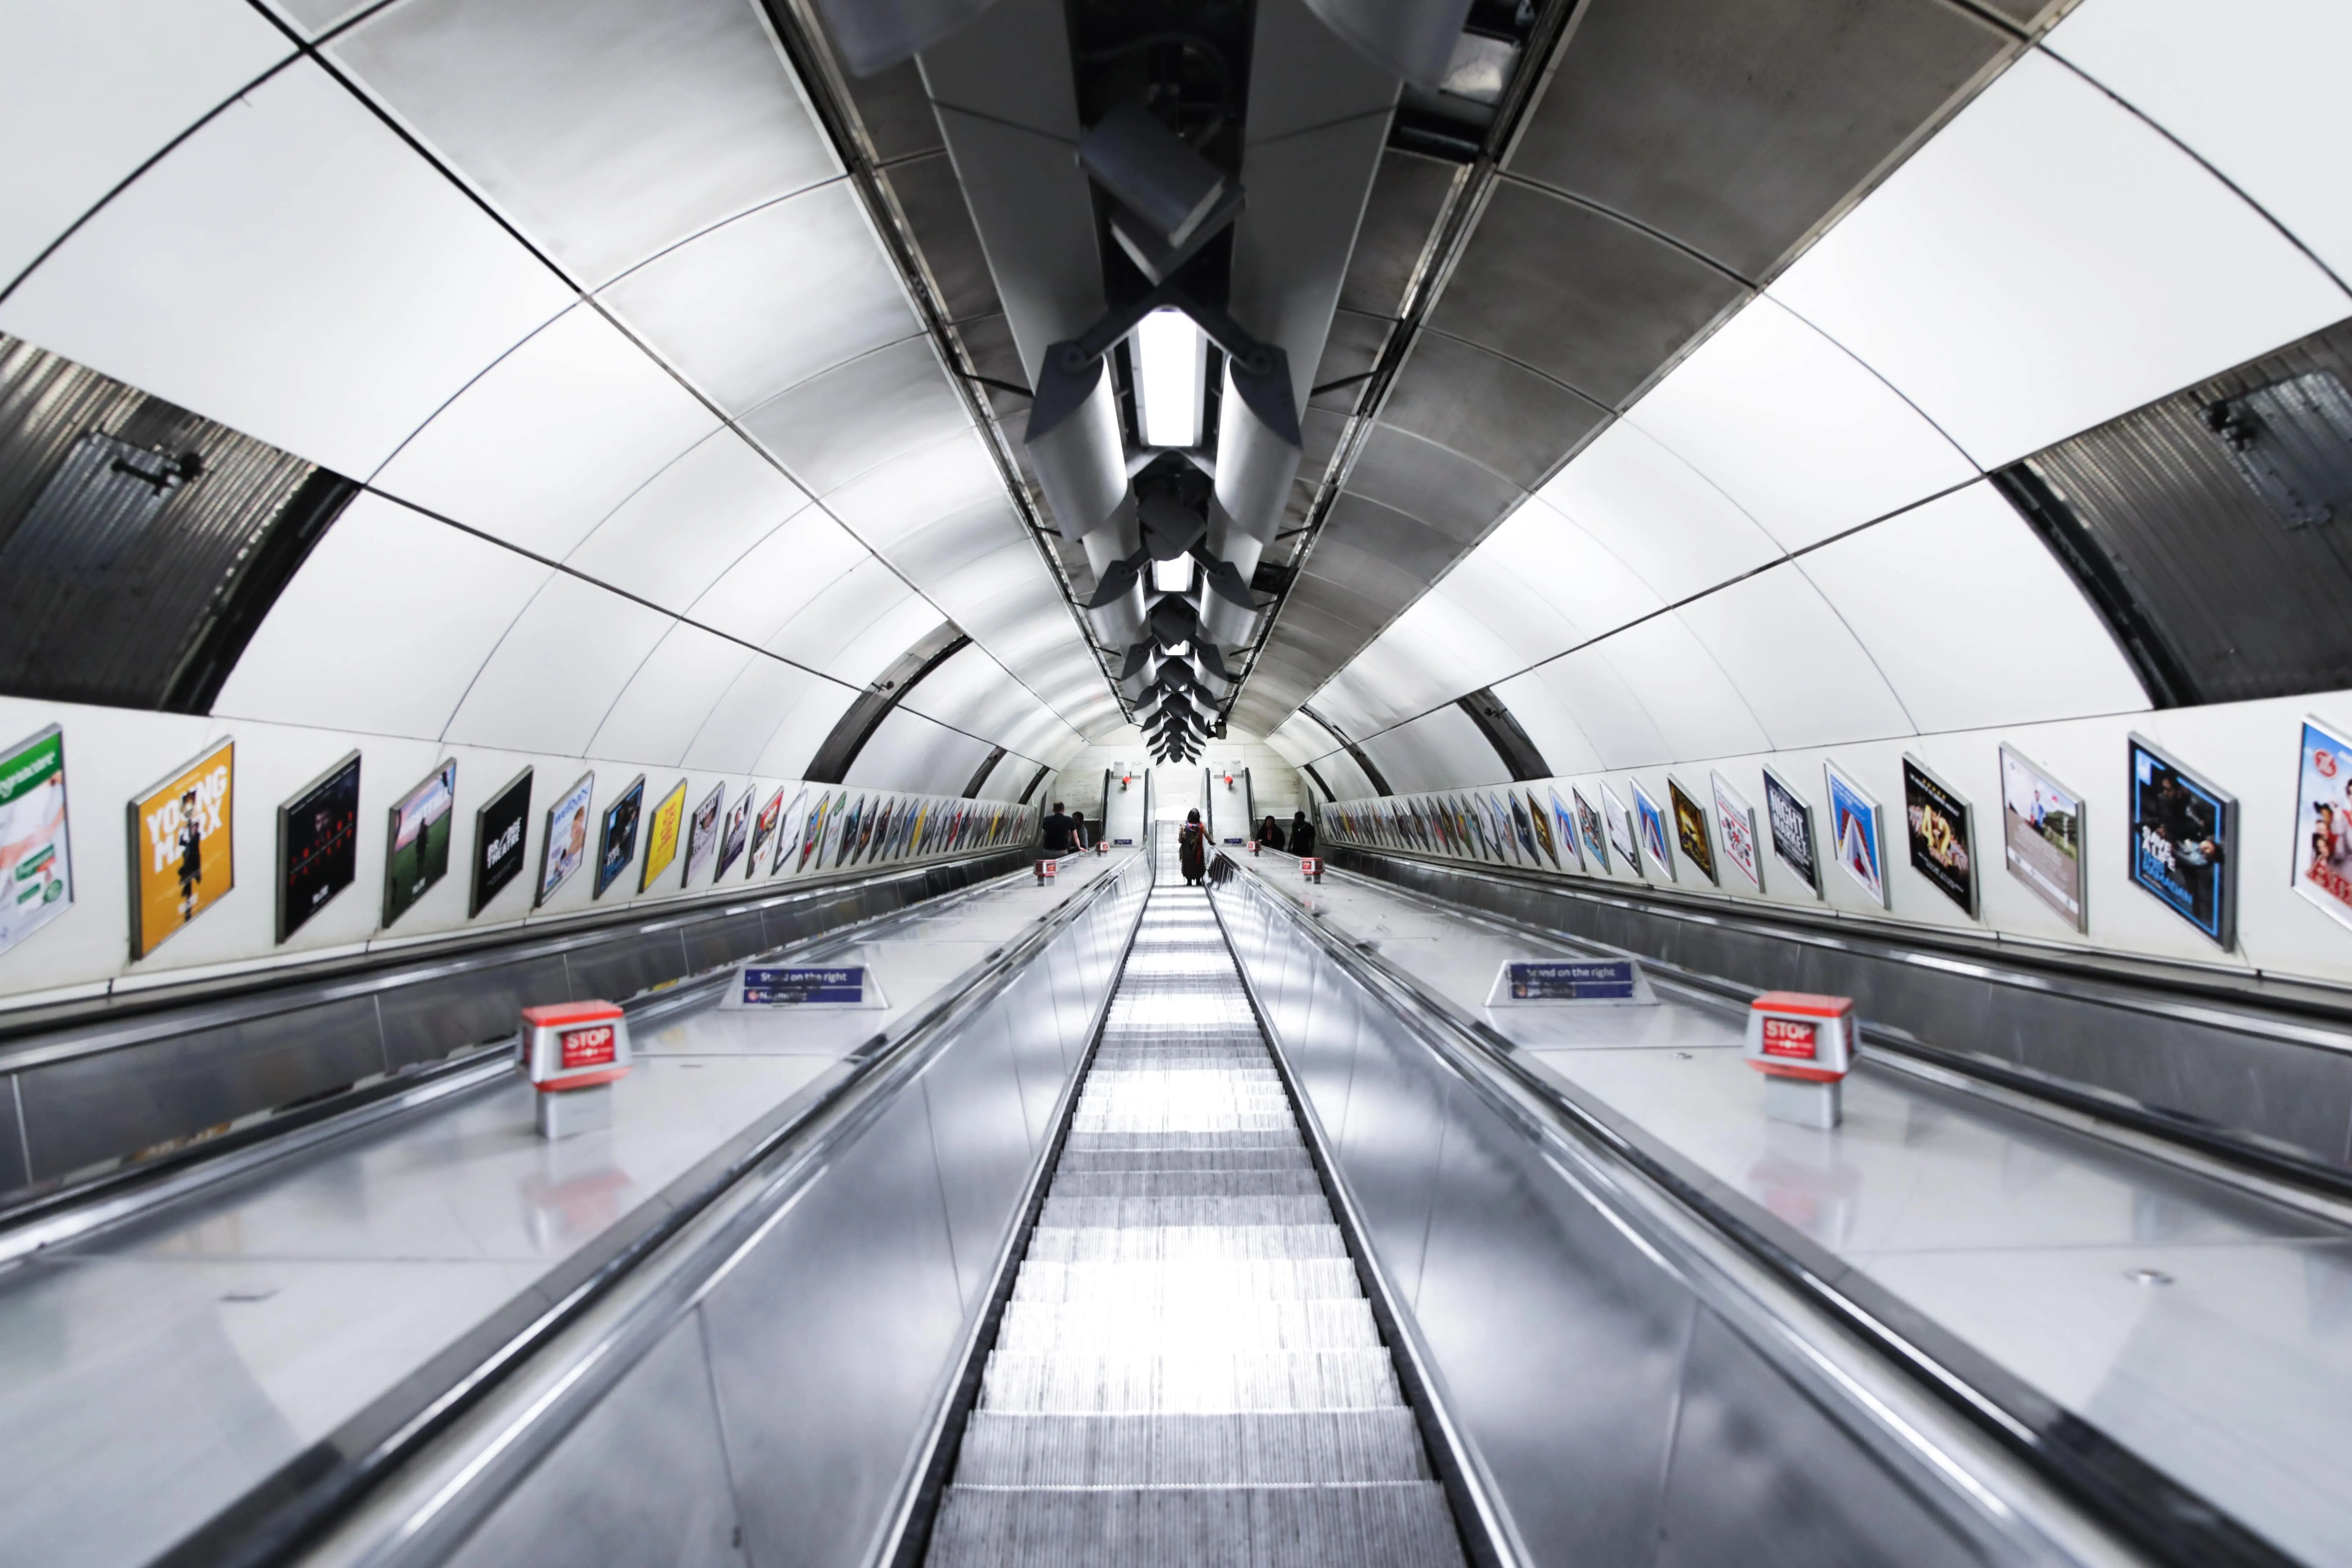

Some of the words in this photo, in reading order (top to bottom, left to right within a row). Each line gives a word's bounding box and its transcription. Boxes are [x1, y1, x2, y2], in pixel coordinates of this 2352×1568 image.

[1770, 789, 1803, 840] NIGHT
[760, 972, 789, 981] Std
[804, 972, 822, 981] the
[823, 972, 847, 983] right
[1557, 969, 1570, 977] on
[1572, 968, 1589, 977] the
[1591, 967, 1615, 978] right
[566, 1028, 611, 1049] STOP
[1766, 1020, 1811, 1040] STOP
